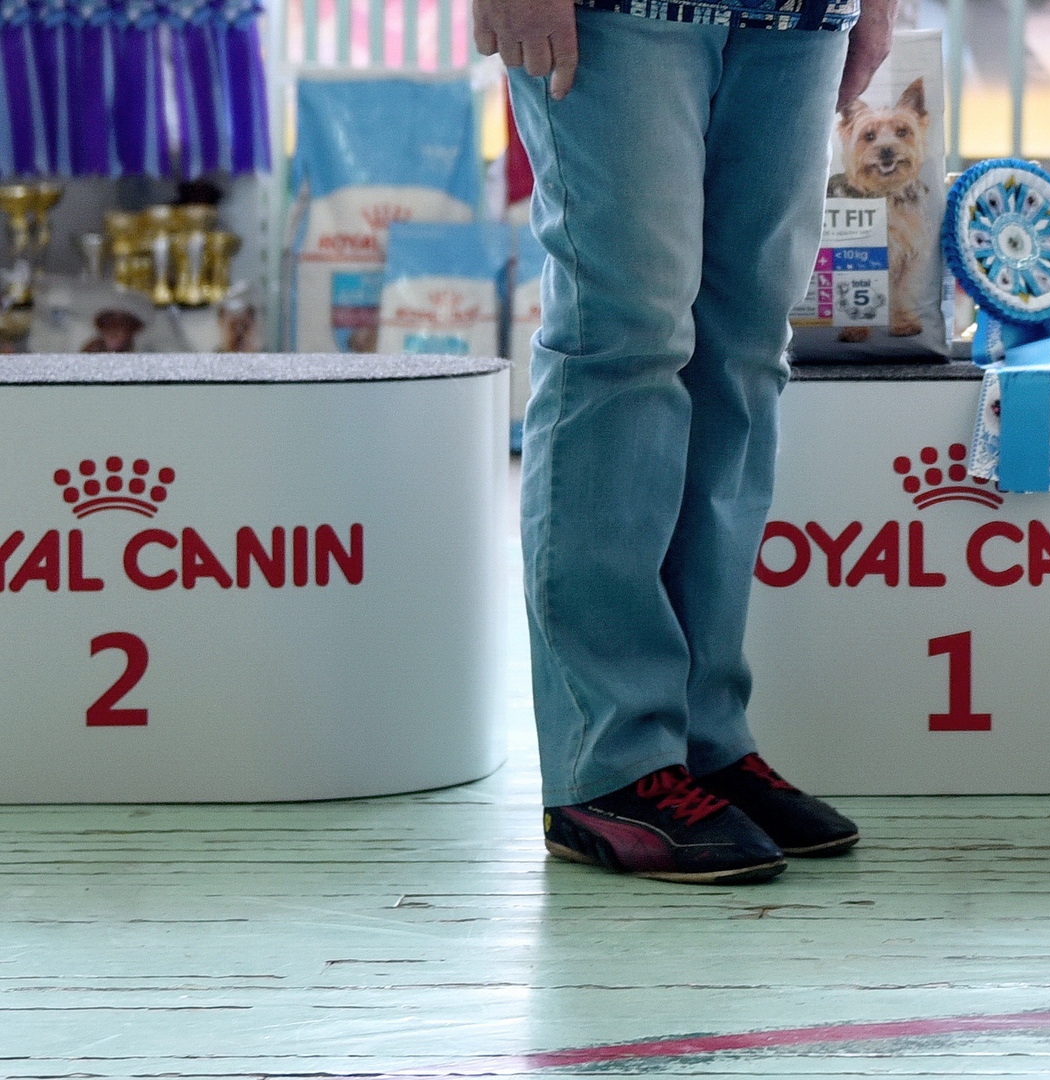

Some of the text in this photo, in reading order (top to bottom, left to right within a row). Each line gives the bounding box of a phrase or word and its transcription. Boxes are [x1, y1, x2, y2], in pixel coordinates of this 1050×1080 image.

[846, 209, 876, 228] FIT
[854, 290, 870, 306] 5
[123, 523, 364, 591] CANIN
[86, 631, 149, 727] 2
[927, 630, 992, 732] 1
